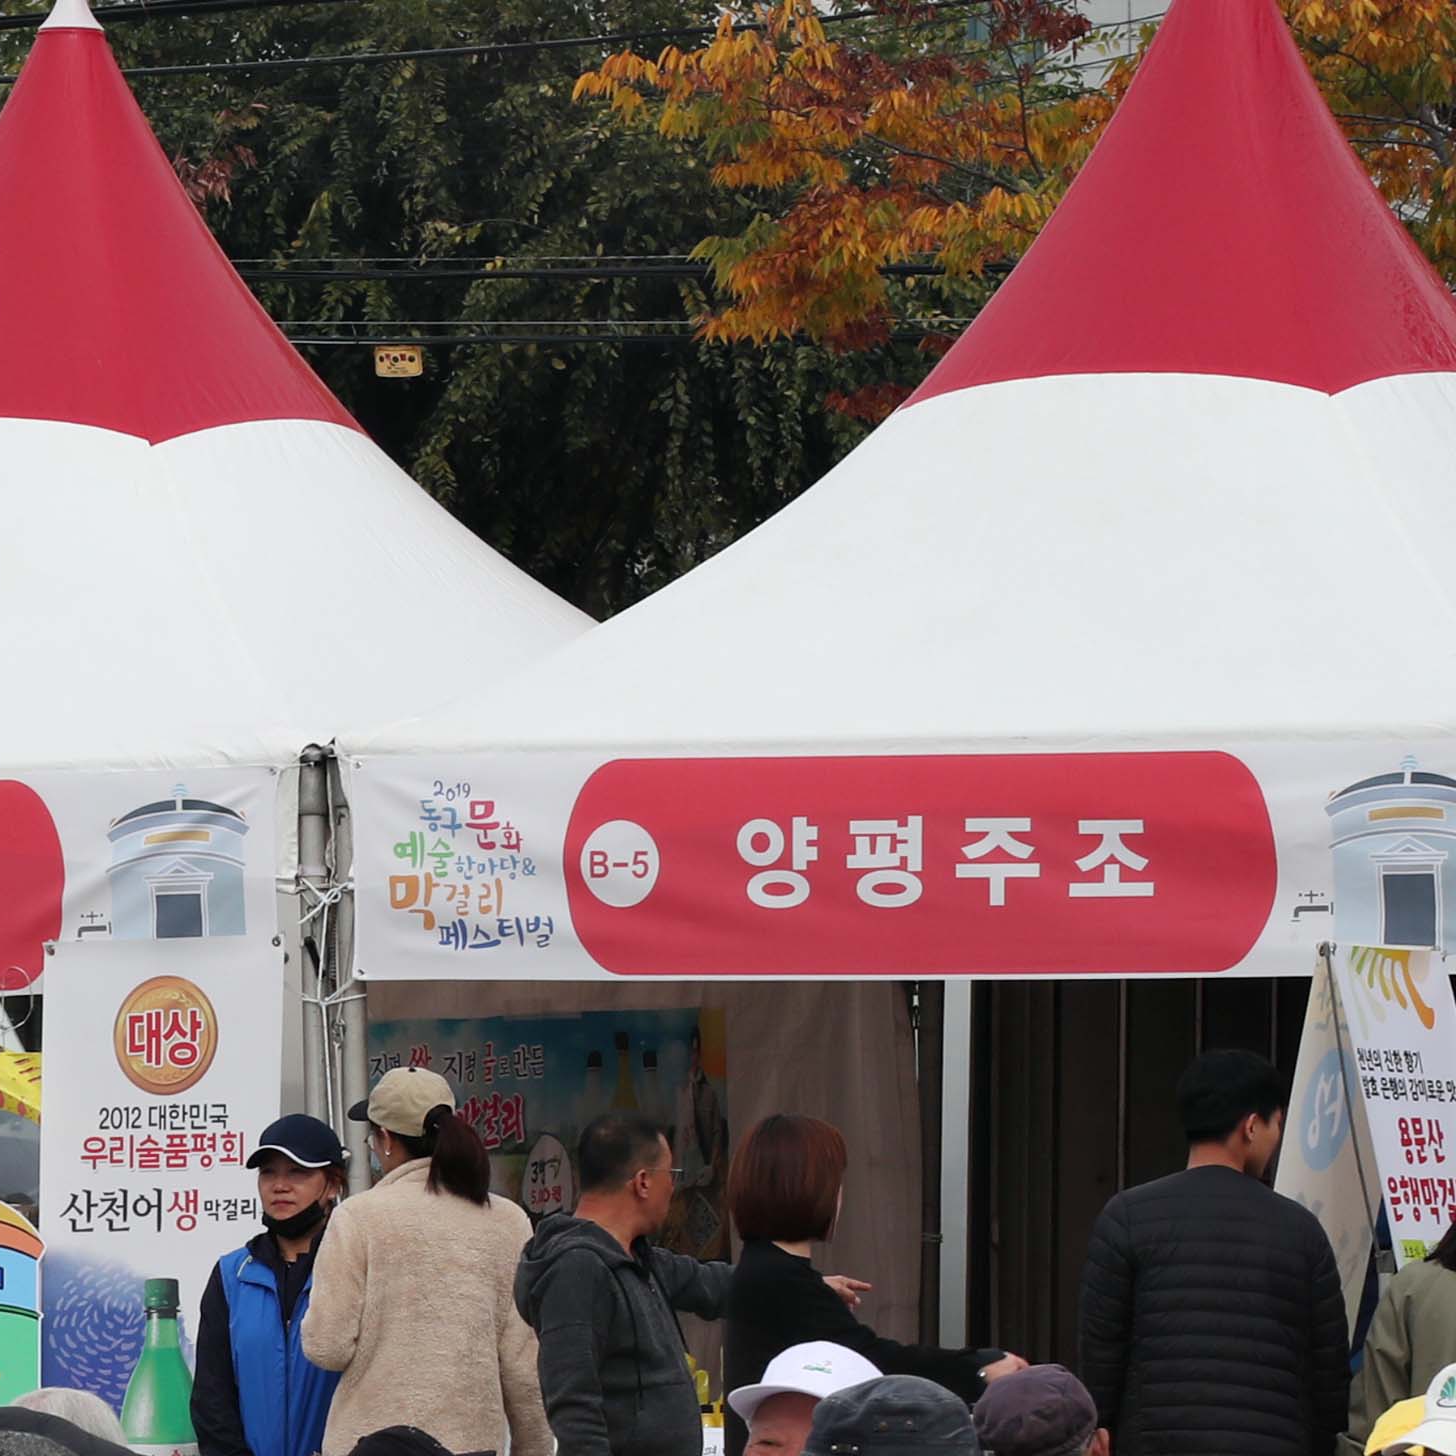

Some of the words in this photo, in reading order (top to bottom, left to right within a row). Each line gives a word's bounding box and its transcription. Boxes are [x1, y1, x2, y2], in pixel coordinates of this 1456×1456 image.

[433, 780, 471, 801] 2019
[589, 850, 649, 879] B-5
[736, 815, 1155, 909] 양평주조
[389, 872, 503, 931] 막걸리
[439, 916, 554, 950] 페스티벌
[127, 1009, 203, 1066] 대상
[99, 1106, 142, 1130] 2012
[148, 1103, 229, 1130] 대한민국
[80, 1131, 246, 1170] 우리술품평회
[1398, 1117, 1445, 1165] 용문산
